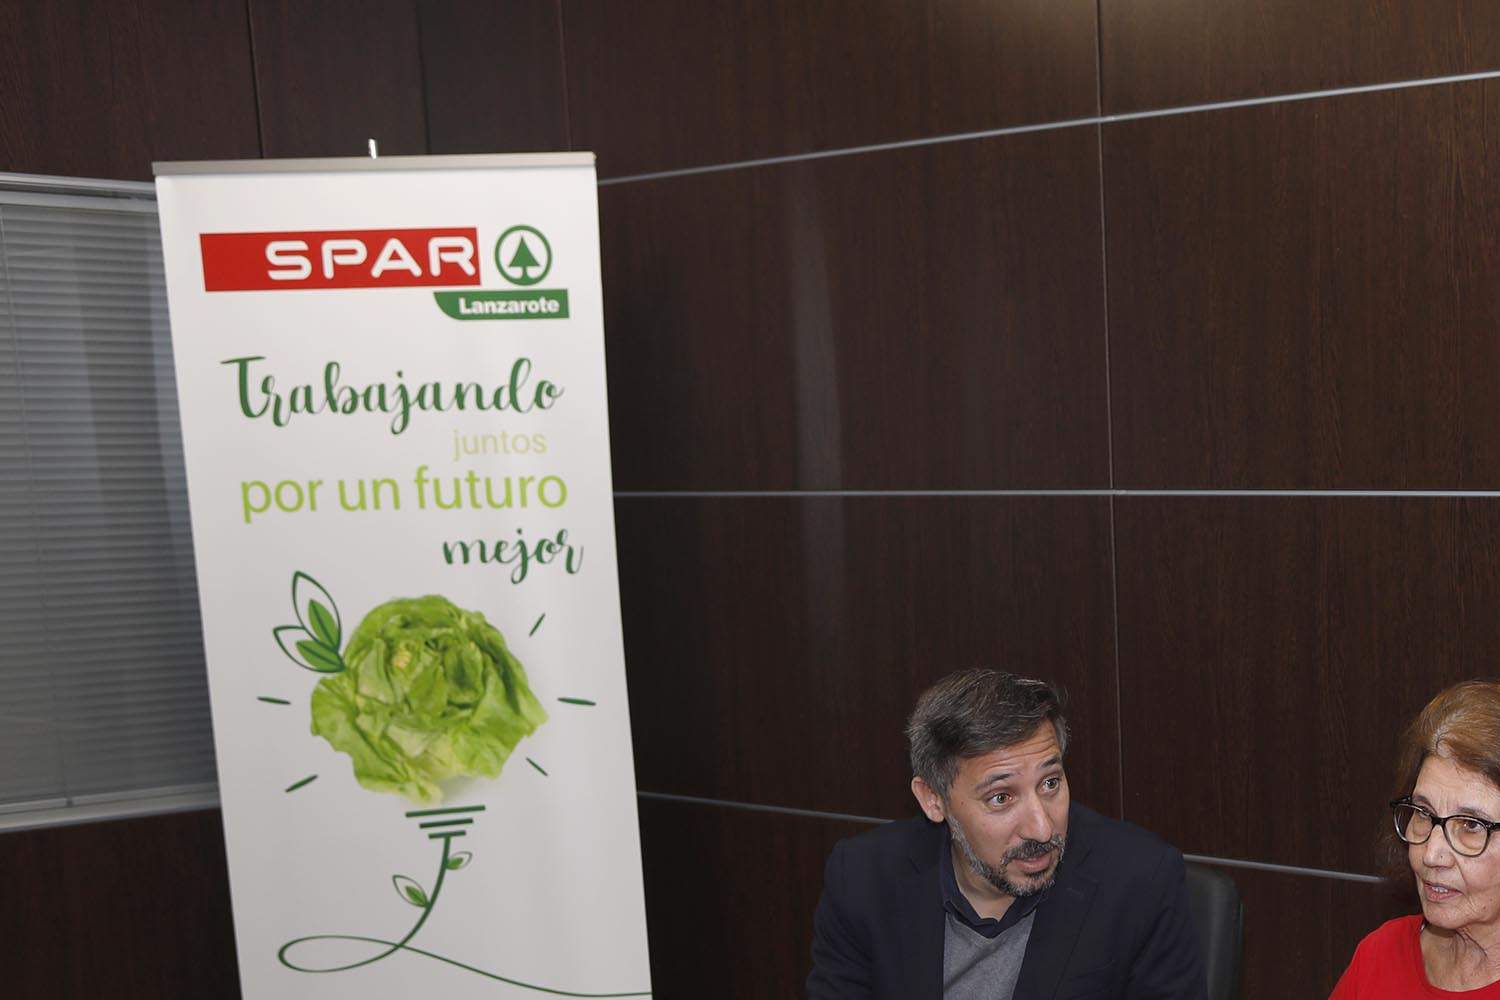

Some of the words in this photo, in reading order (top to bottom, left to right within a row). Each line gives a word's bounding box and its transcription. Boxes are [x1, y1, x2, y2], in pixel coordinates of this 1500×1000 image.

[265, 236, 476, 280] SPAR
[458, 296, 559, 315] Lanzarote
[221, 356, 564, 435] Trabajando
[453, 429, 547, 461] juntos
[241, 478, 323, 524] por
[339, 477, 400, 511] un
[413, 466, 568, 510] futuro
[443, 529, 583, 585] mejor
